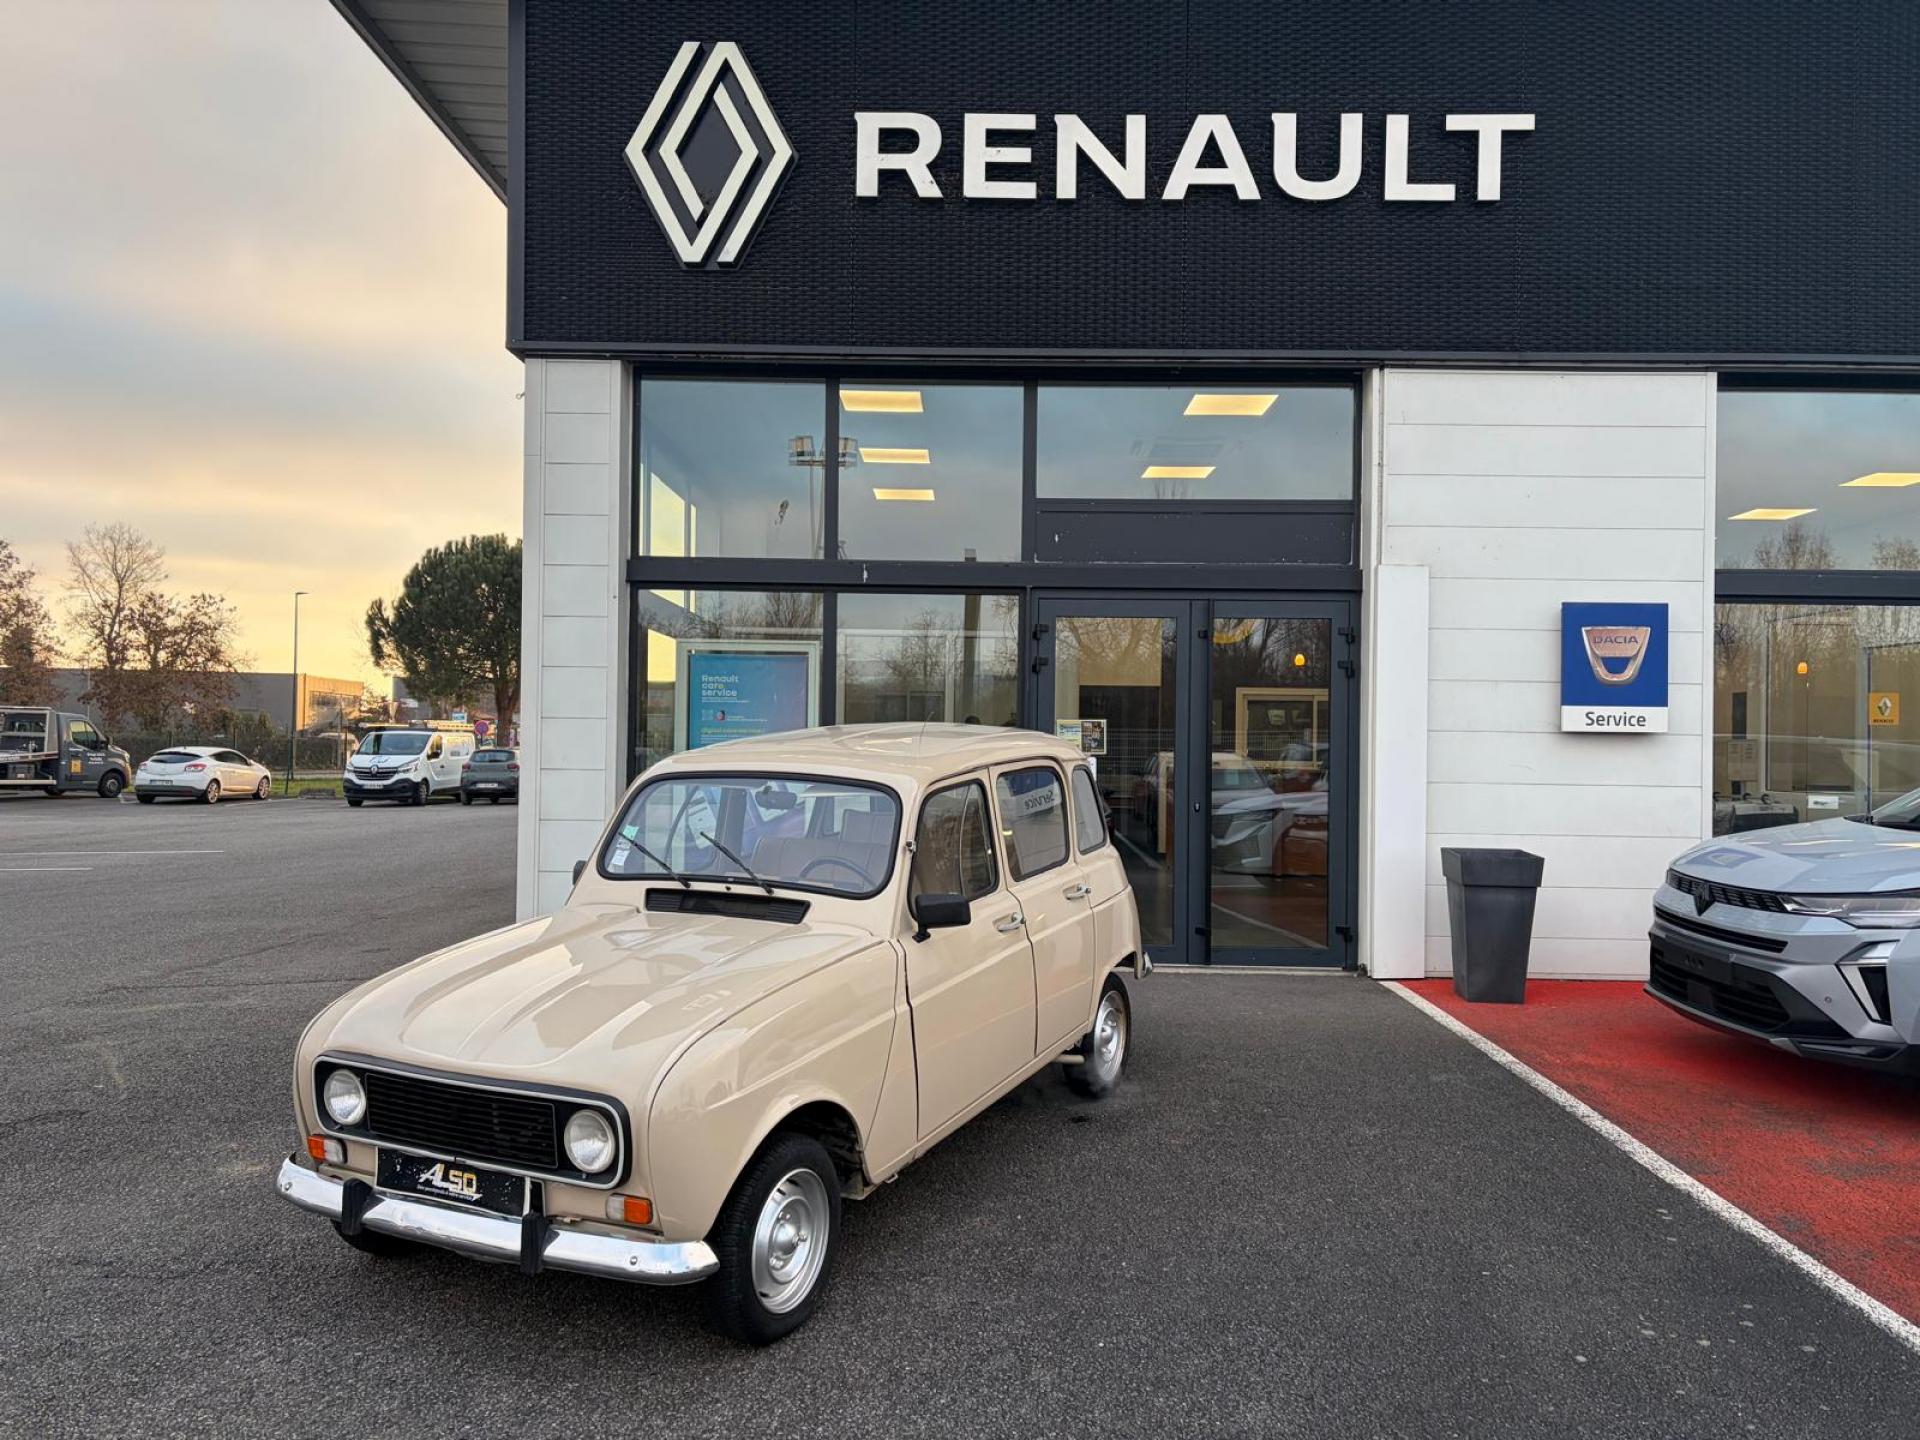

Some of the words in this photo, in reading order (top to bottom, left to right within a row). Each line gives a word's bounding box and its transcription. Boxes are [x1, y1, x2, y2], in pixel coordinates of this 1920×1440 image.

[854, 111, 1536, 201] RENAULT
[1593, 635, 1639, 644] DACIA
[702, 674, 739, 682] Renault
[702, 689, 737, 697] service
[1585, 711, 1647, 727] Service
